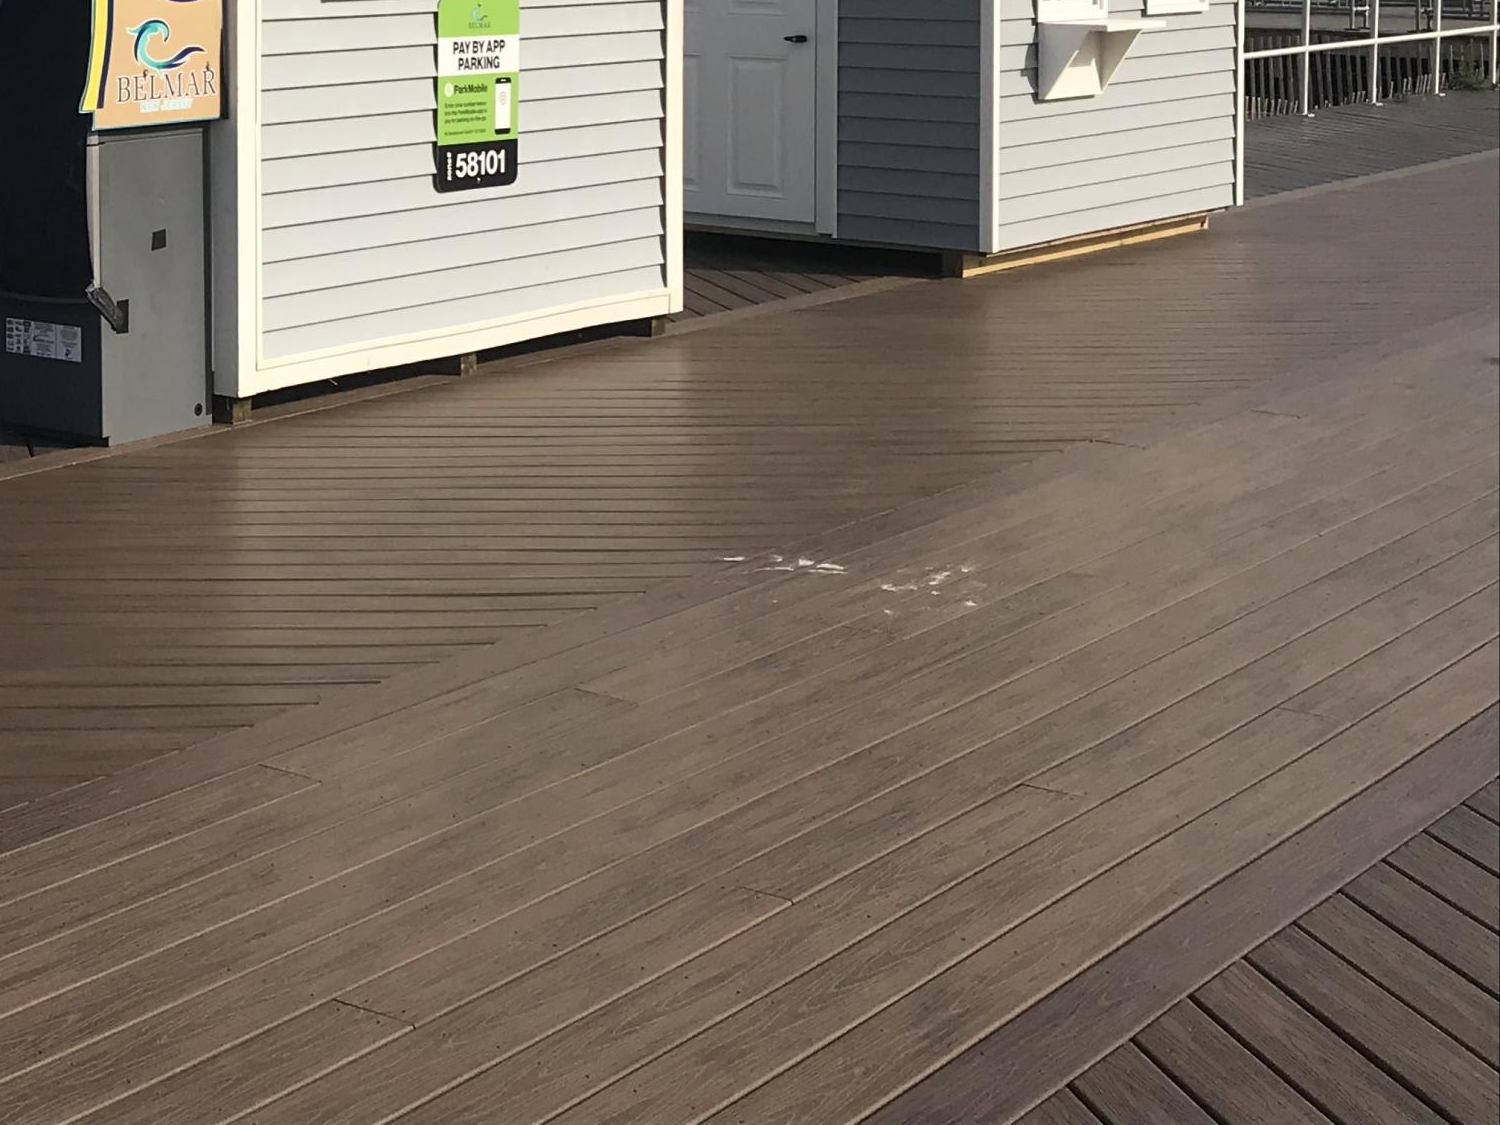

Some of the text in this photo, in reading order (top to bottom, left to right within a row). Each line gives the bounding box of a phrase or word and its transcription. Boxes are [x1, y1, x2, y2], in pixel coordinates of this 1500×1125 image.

[453, 39, 506, 55] PAY BY APP
[458, 56, 500, 71] PARKING
[116, 68, 218, 104] BELMAR
[453, 83, 488, 94] ParkMobile
[455, 148, 506, 178] 58101
